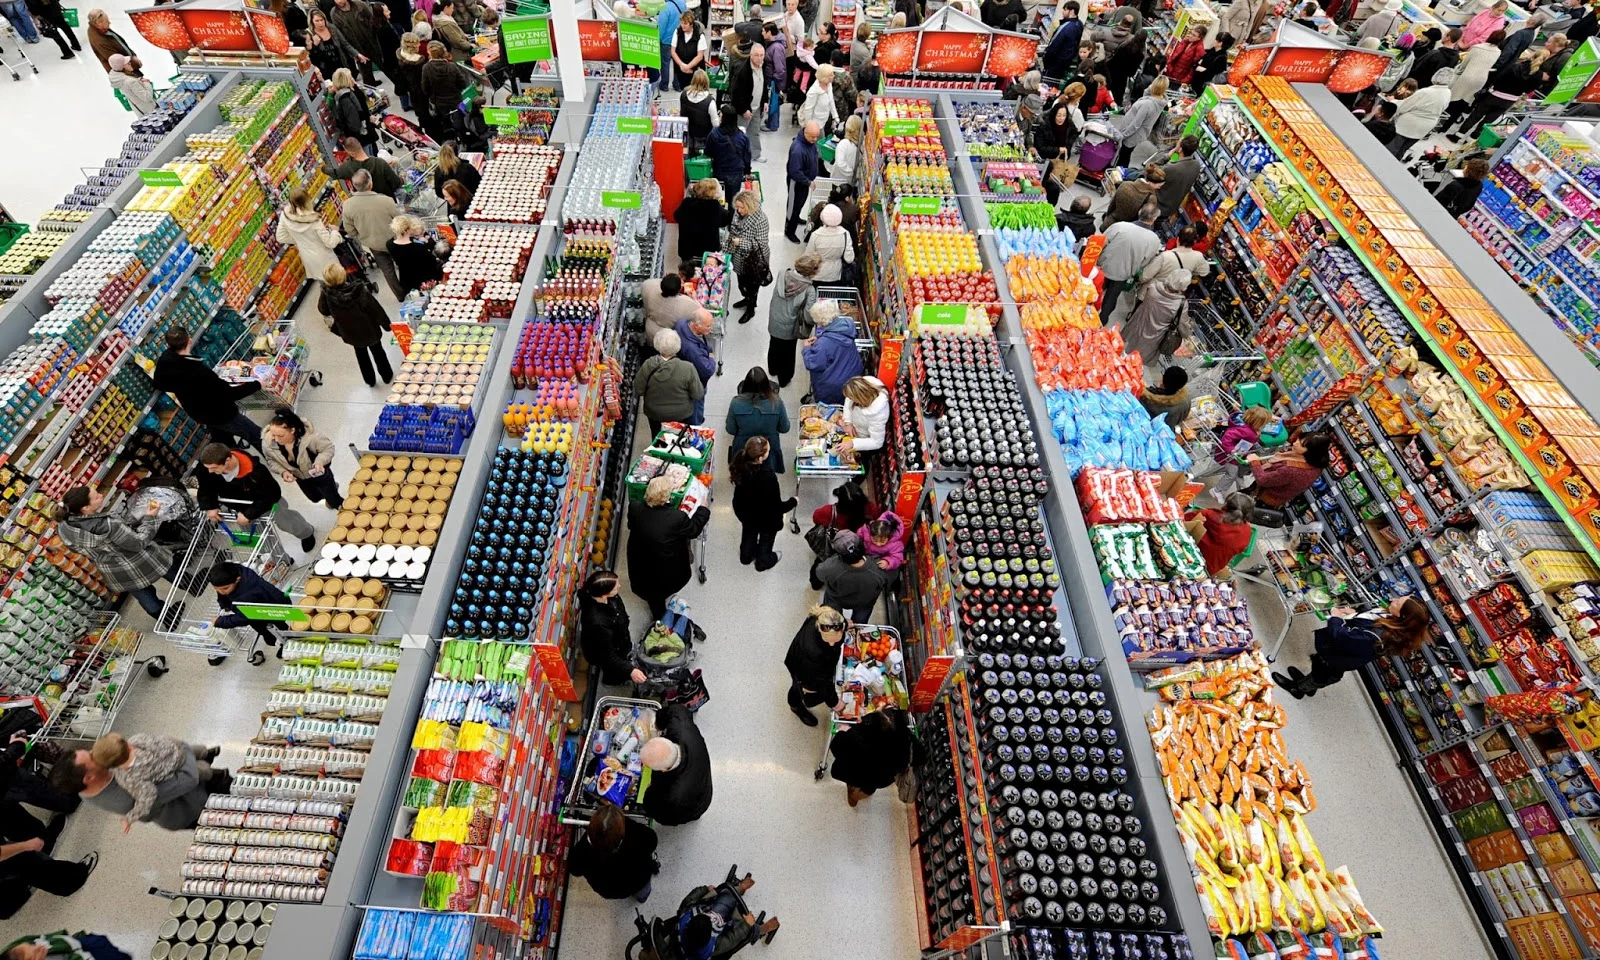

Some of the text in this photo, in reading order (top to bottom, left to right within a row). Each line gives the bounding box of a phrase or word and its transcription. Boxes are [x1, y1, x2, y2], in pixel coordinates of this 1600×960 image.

[193, 28, 245, 36] CHRISTMAS
[505, 31, 547, 41] SAVING
[582, 40, 611, 48] STMAS
[622, 34, 660, 46] SAVING
[925, 50, 978, 58] CHRISTMAS
[1274, 64, 1328, 74] CHRISTMAS
